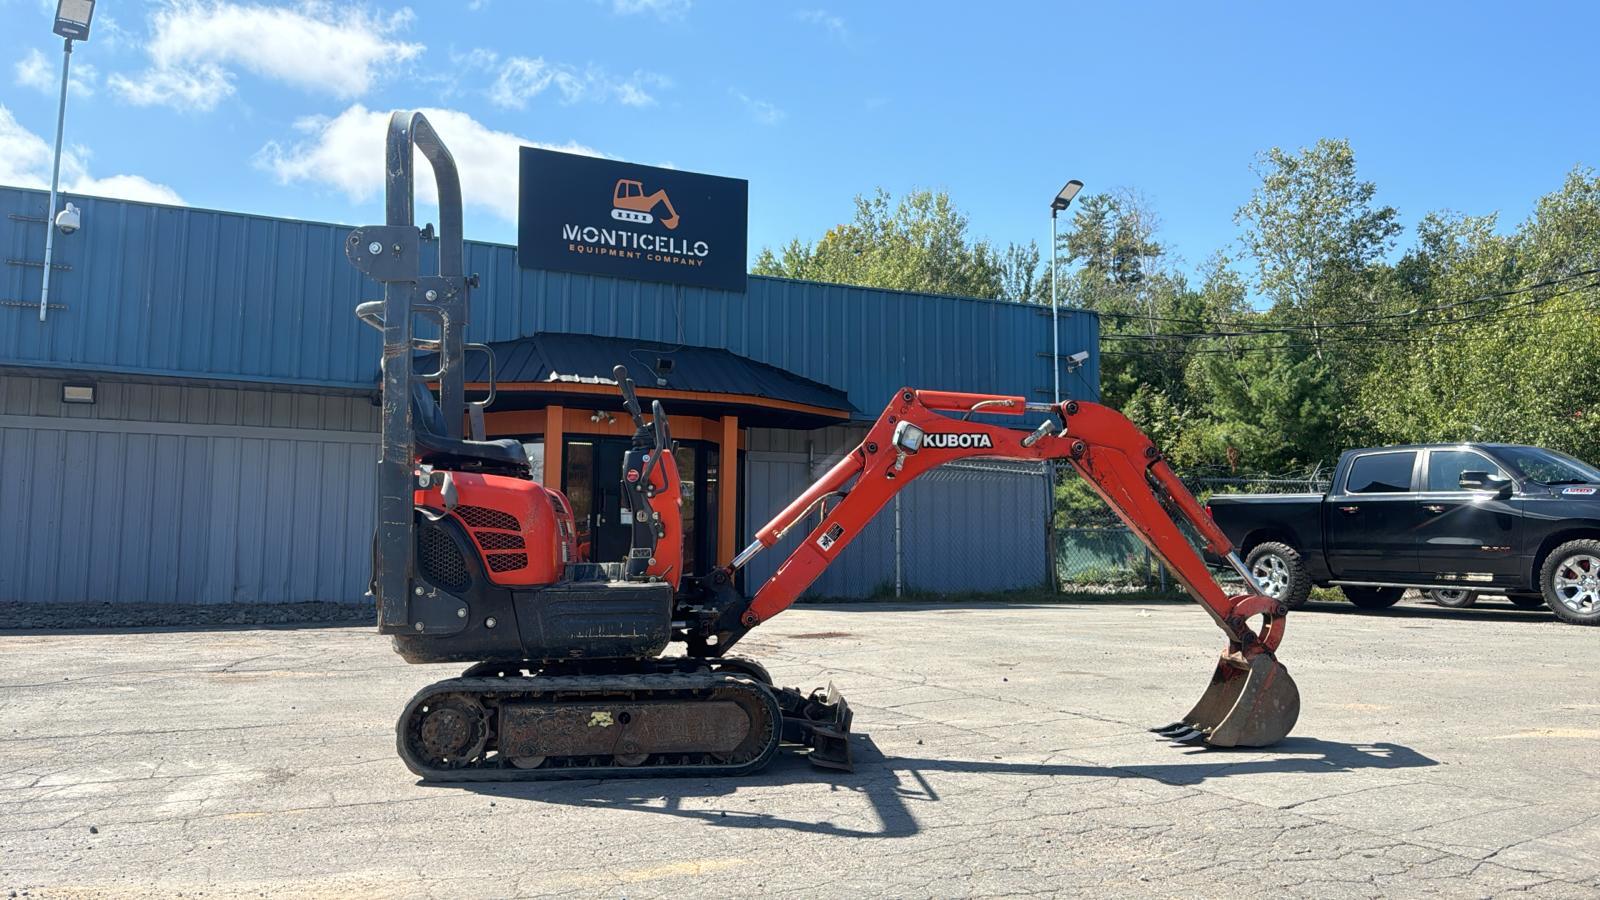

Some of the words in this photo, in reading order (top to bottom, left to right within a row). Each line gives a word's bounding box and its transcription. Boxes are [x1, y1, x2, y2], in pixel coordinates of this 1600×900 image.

[562, 223, 709, 257] MONTICELLO
[569, 243, 642, 260] EQUIPMENT
[647, 253, 703, 267] COMPANY
[923, 433, 992, 448] KUBOTA
